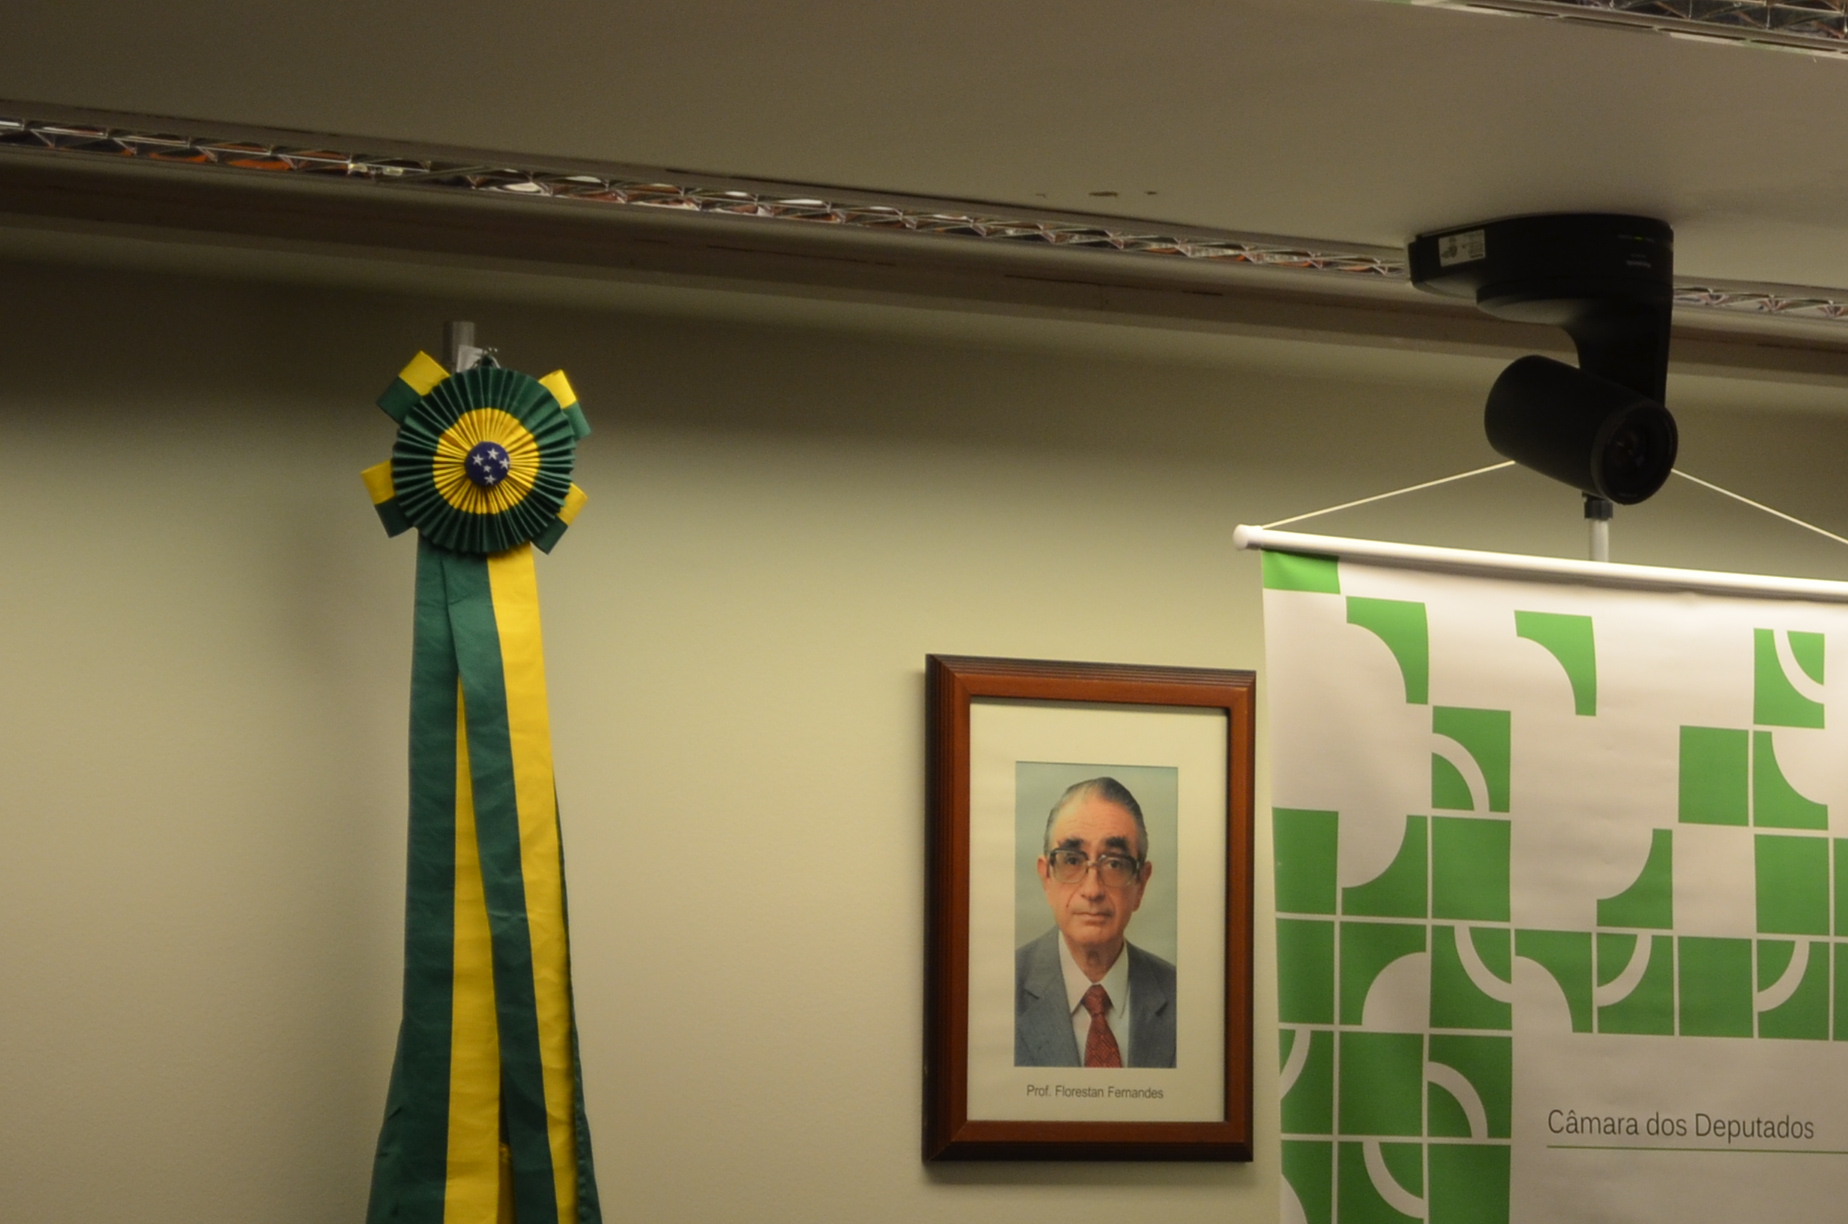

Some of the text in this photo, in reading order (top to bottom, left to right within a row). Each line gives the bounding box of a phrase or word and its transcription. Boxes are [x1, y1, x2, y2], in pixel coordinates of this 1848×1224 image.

[1026, 1084, 1164, 1099] Prof. Florestan Fernandes
[1547, 1109, 1815, 1144] Câmara dos Deputados
